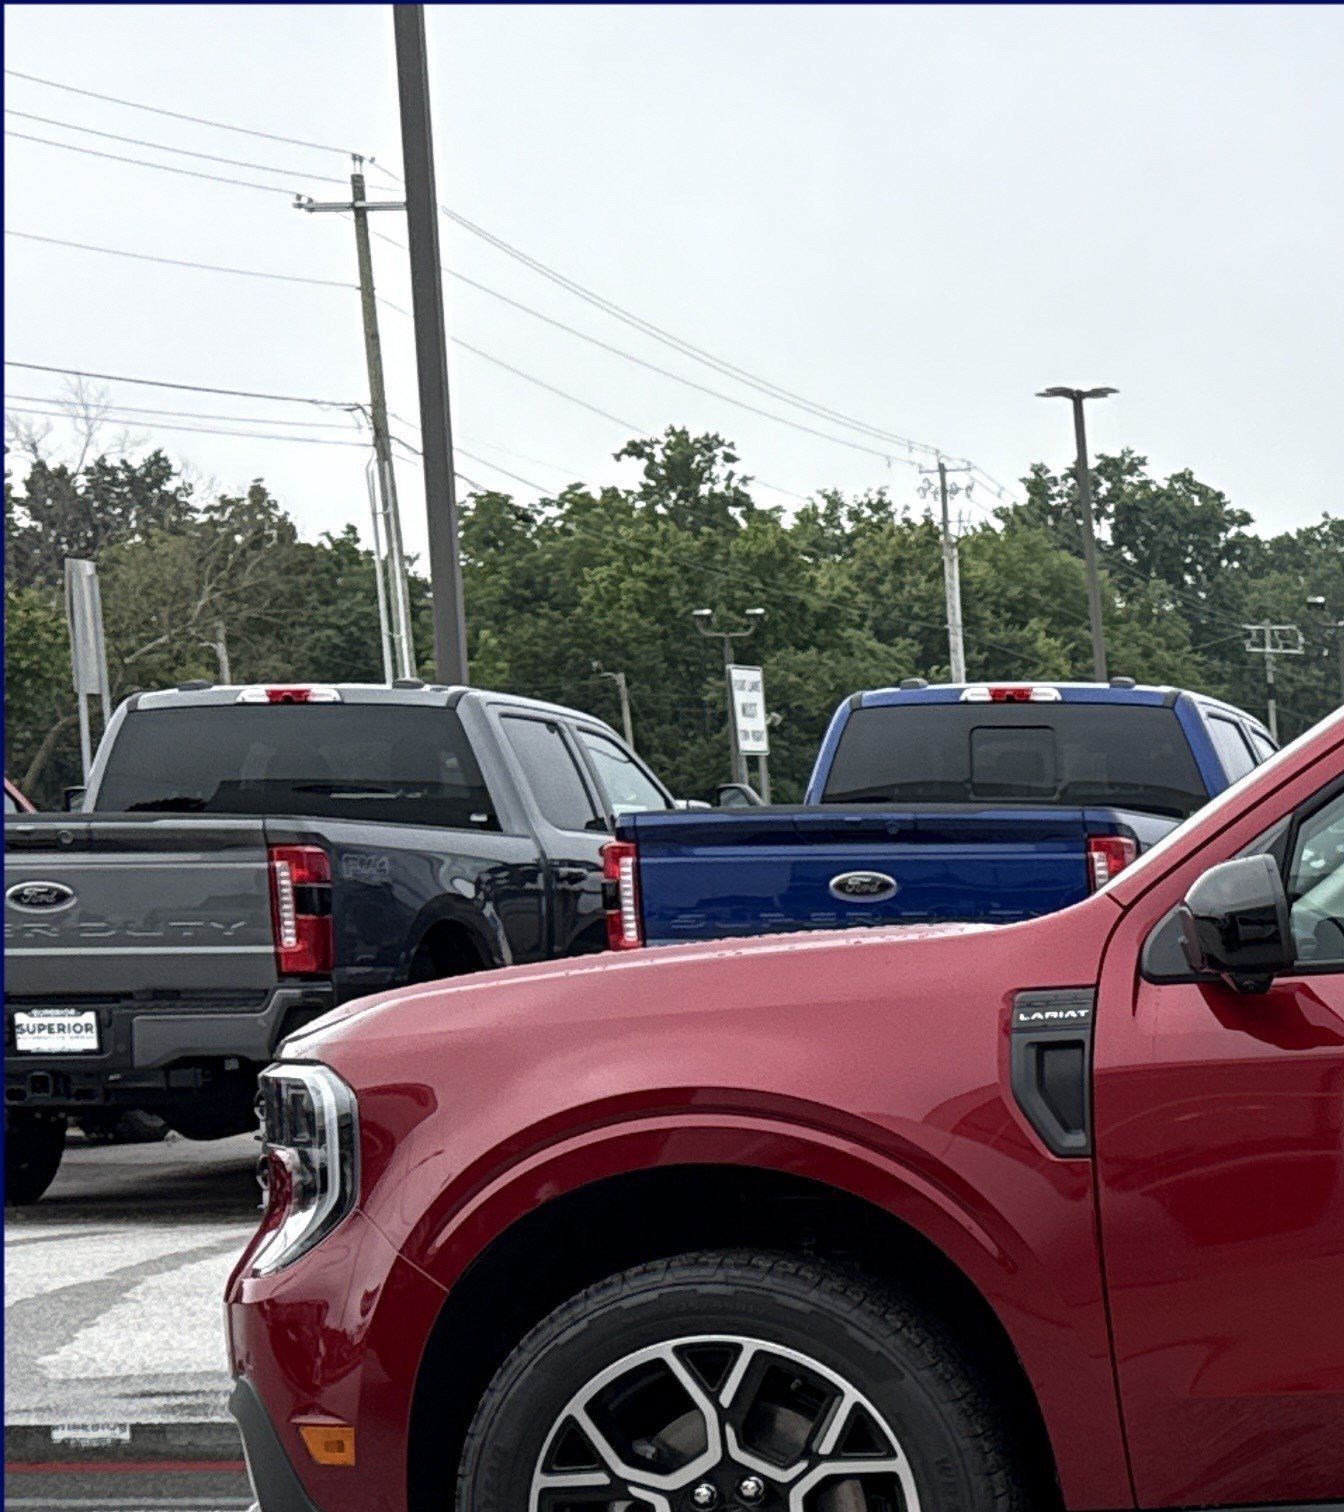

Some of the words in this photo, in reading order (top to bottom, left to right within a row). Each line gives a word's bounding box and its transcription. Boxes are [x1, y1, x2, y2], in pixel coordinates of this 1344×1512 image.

[20, 886, 59, 903] Ford
[1018, 1009, 1090, 1021] LARIAT
[15, 1022, 95, 1035] SUPERIOR
